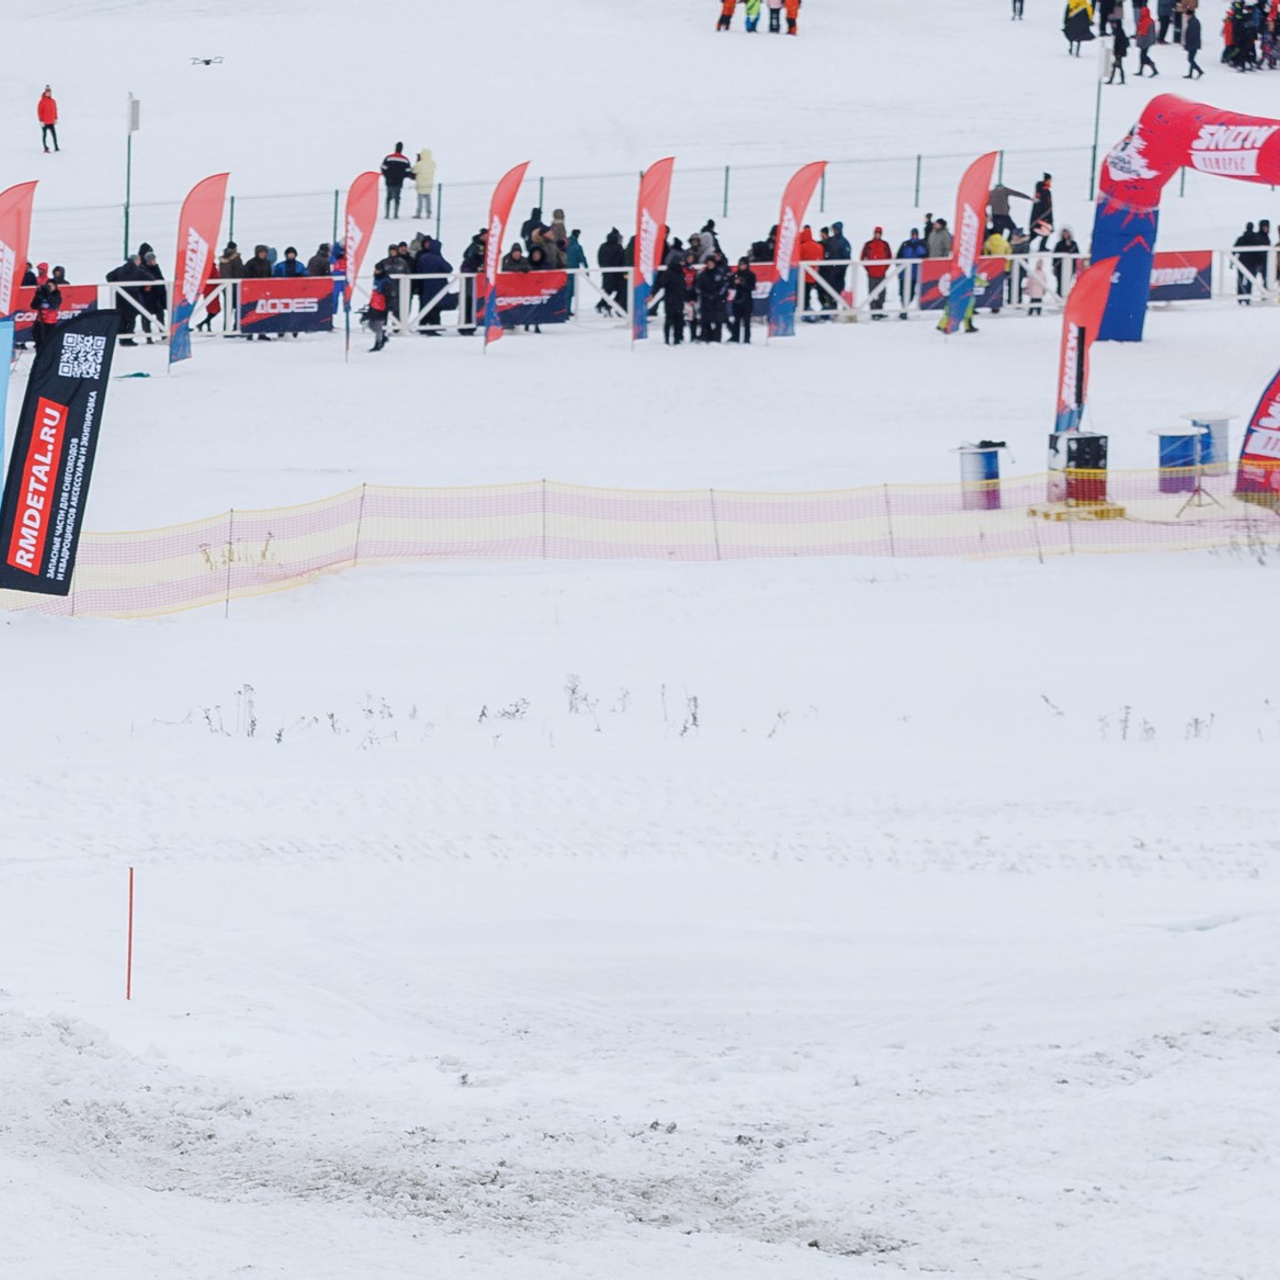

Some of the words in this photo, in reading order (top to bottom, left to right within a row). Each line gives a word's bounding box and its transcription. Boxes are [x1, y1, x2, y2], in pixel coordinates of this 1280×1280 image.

[15, 406, 61, 568] RMDETAL.RU
[58, 508, 77, 573] КВАДРОЦИКЛОВ
[70, 455, 86, 507] АКСЕССУАРЫ
[80, 390, 97, 446] ЭКИПИРОВКА
[62, 437, 79, 492] СНЕГОХОДОВ
[54, 510, 66, 536] ЧАСТИ
[59, 492, 70, 510] ДЛЯ
[46, 536, 61, 579] ЗАПАСНЫЕ
